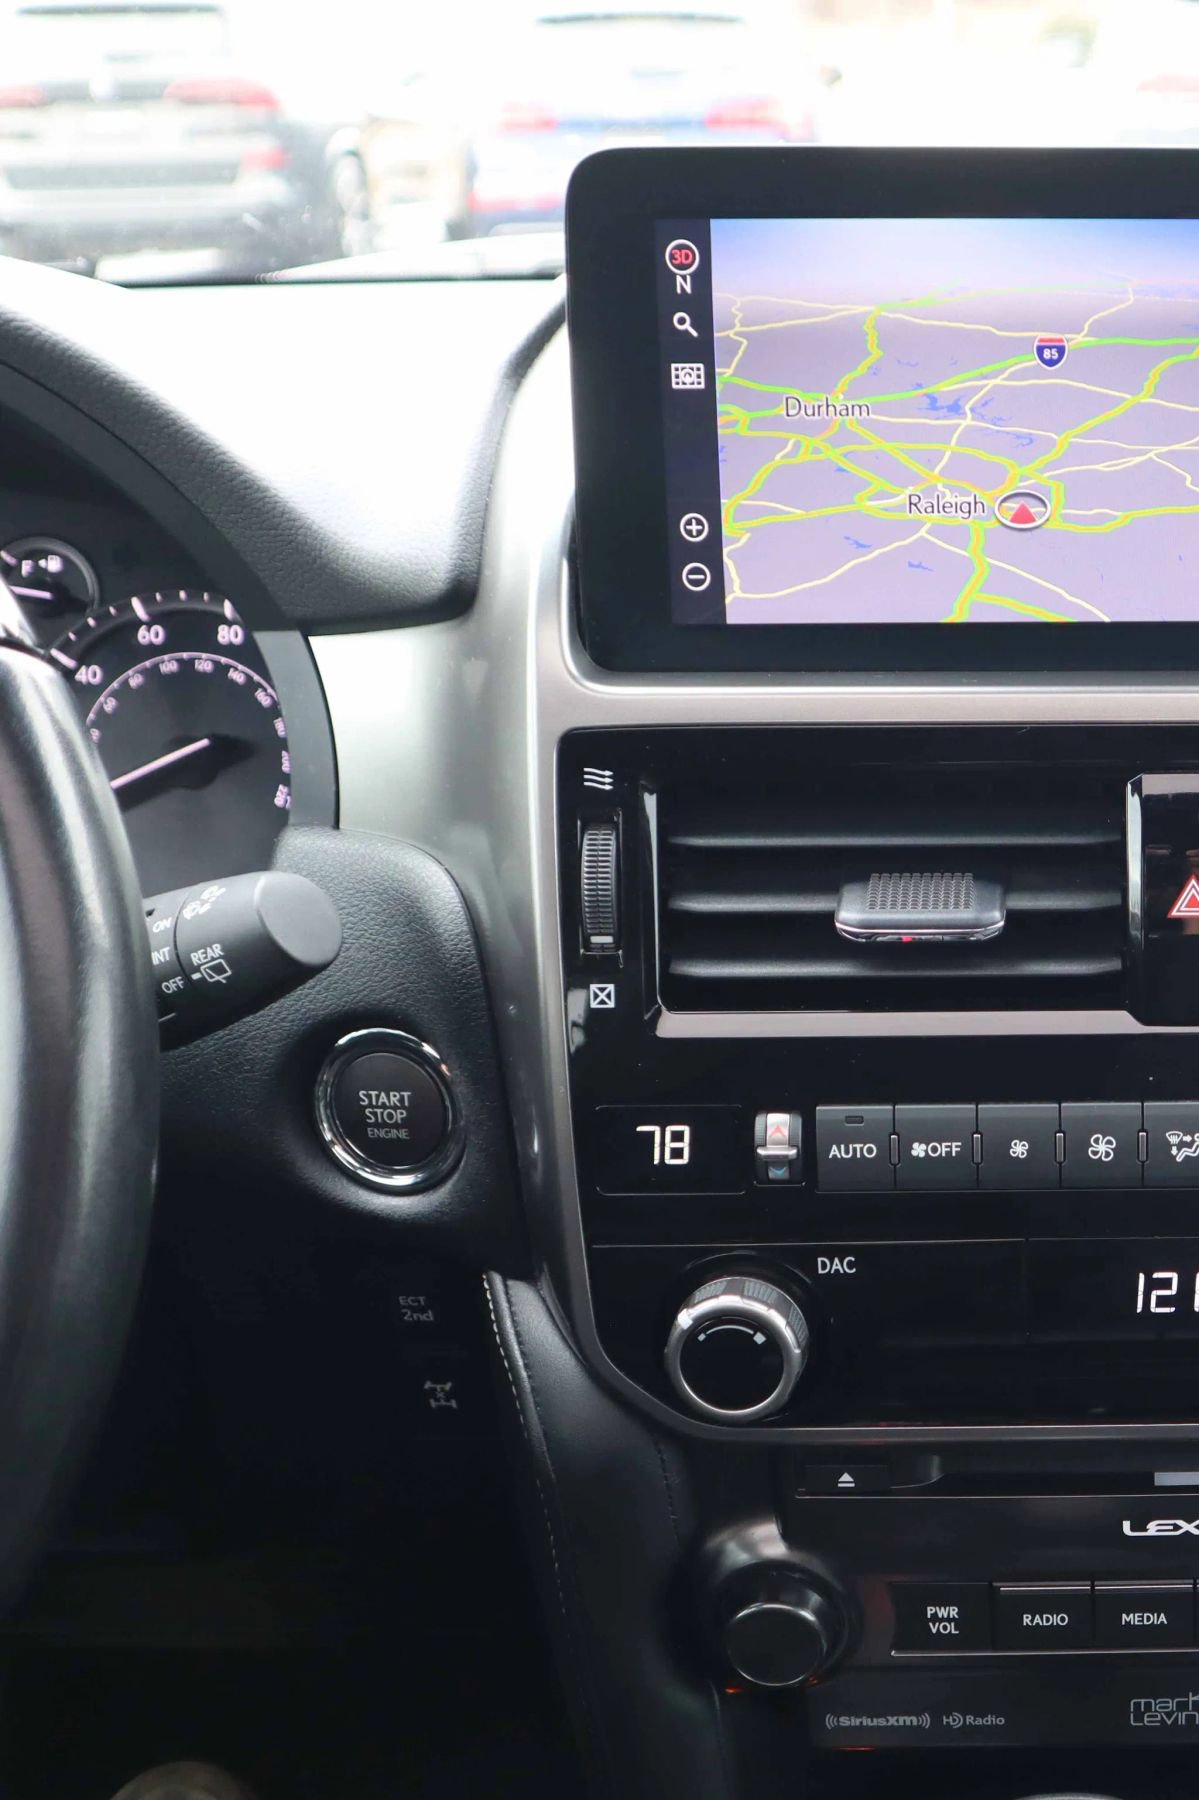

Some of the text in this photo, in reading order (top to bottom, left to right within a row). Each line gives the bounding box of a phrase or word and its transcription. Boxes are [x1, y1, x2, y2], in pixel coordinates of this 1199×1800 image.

[672, 248, 693, 265] 3D
[675, 276, 692, 295] N
[1042, 347, 1060, 360] 85
[784, 396, 871, 418] Durham
[907, 493, 986, 517] Raleigh
[137, 624, 166, 645] 60
[217, 624, 245, 645] 80
[75, 665, 102, 685] 40
[193, 659, 215, 674] 120
[152, 916, 172, 934] ON
[150, 945, 170, 966] INT
[190, 943, 225, 967] REAR
[161, 976, 185, 994] OFF
[358, 1090, 412, 1107] START
[364, 1107, 407, 1124] STOP
[366, 1127, 410, 1140] ENGINE
[635, 1124, 691, 1165] 78
[828, 1143, 877, 1159] AUTO
[927, 1141, 962, 1157] OFF
[817, 1256, 857, 1274] DAC
[398, 1295, 427, 1306] ECT
[400, 1308, 435, 1321] 2nd
[926, 1606, 959, 1619] PWR
[1023, 1613, 1069, 1626] RADIO
[1121, 1612, 1168, 1626] MEDIA
[928, 1621, 960, 1634] VOL
[965, 1714, 1005, 1726] Radio
